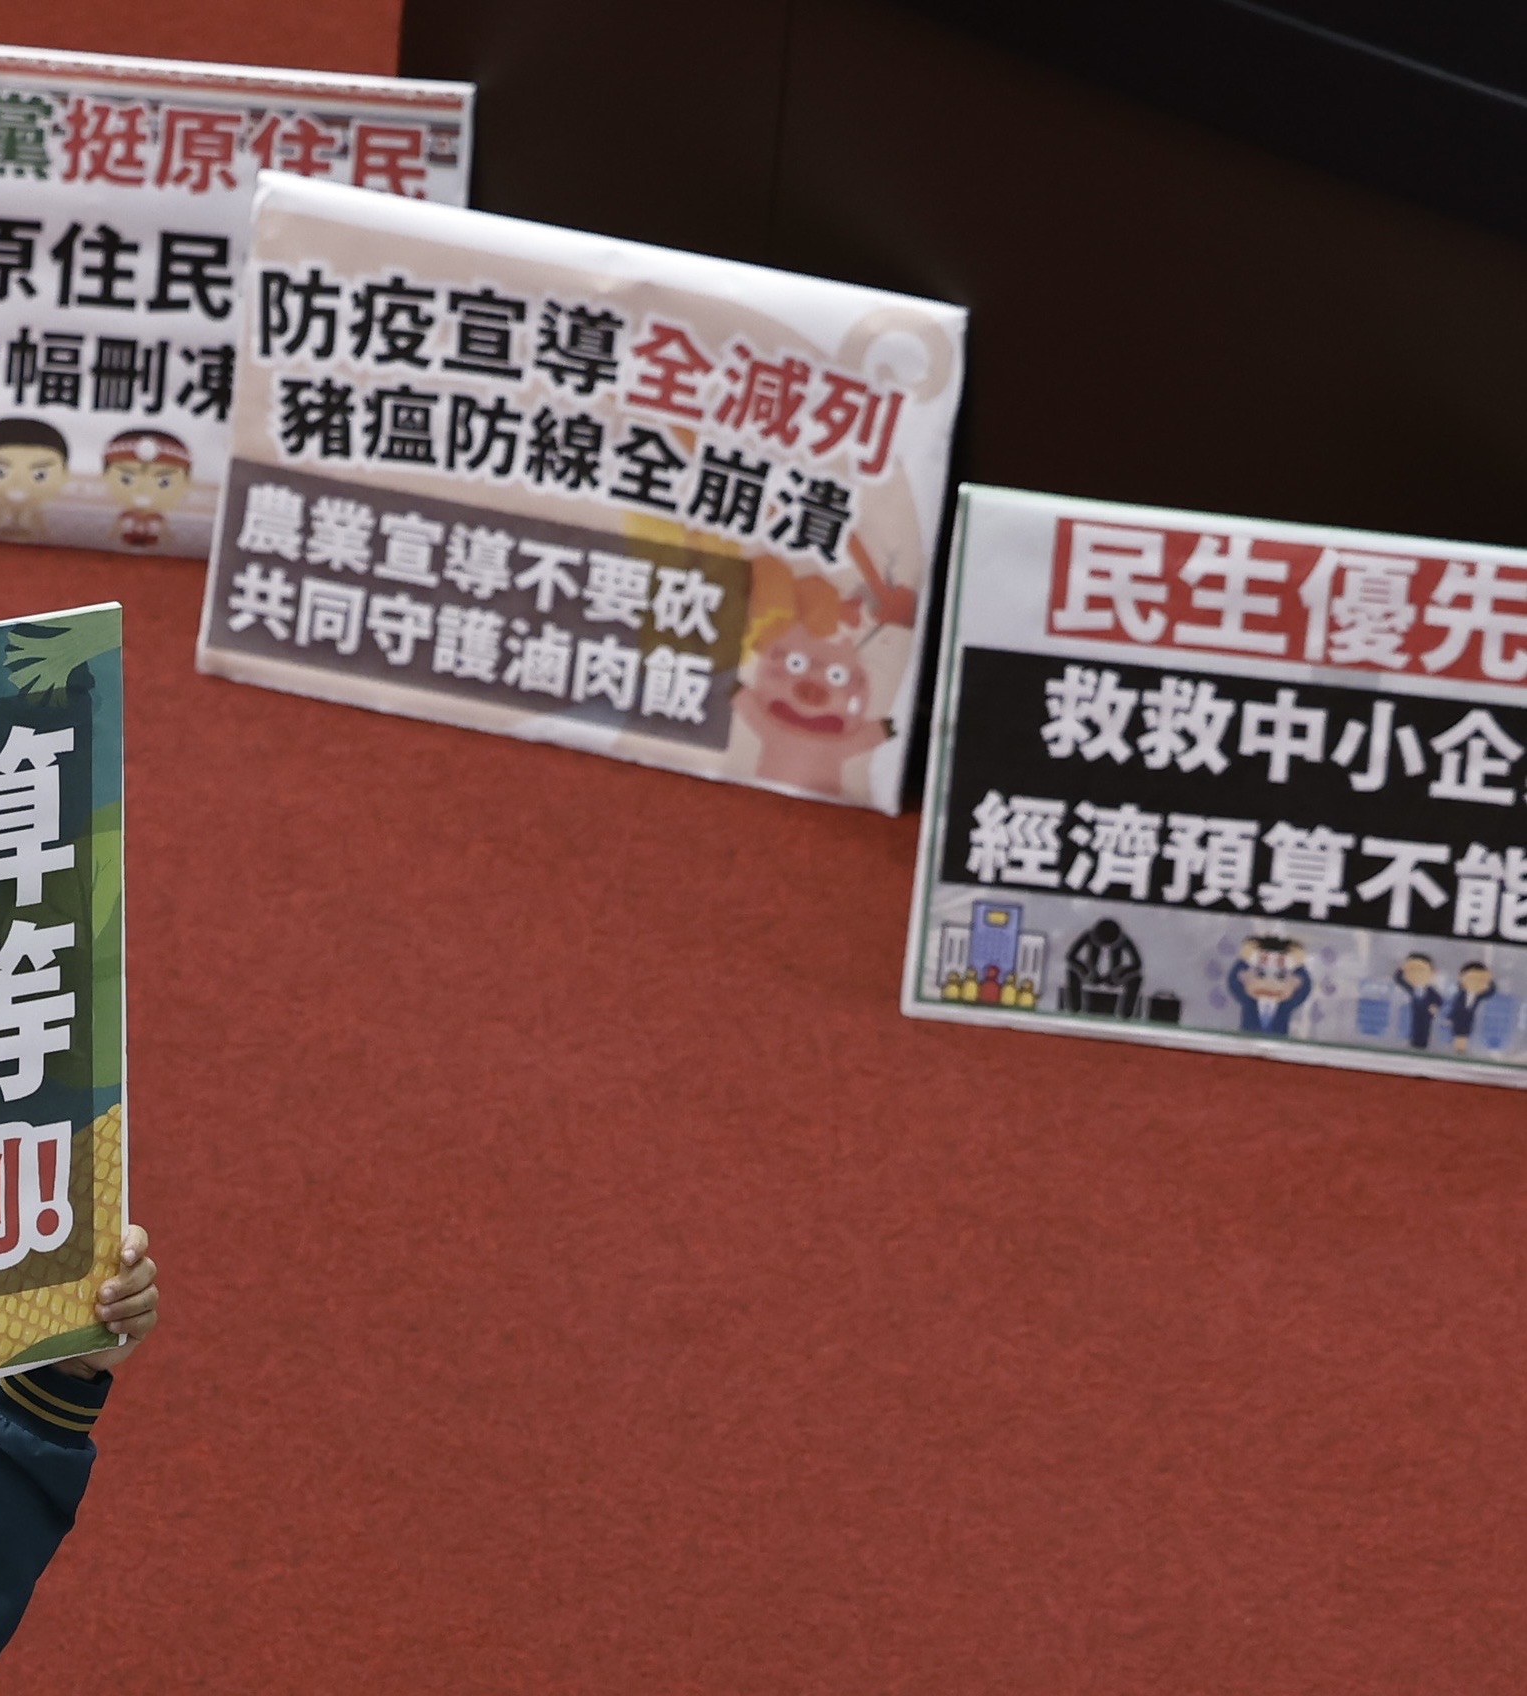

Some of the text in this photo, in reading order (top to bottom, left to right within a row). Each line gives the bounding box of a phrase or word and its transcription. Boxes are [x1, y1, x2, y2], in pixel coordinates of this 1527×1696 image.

[257, 267, 906, 477] 防疫宣導全減列
[278, 376, 852, 566] 豬瘟防線全崩潰
[229, 563, 714, 726] 共同守護滷肉飯
[237, 482, 725, 646] 農業宣導不要砍
[1041, 664, 1527, 806] 救救中小企
